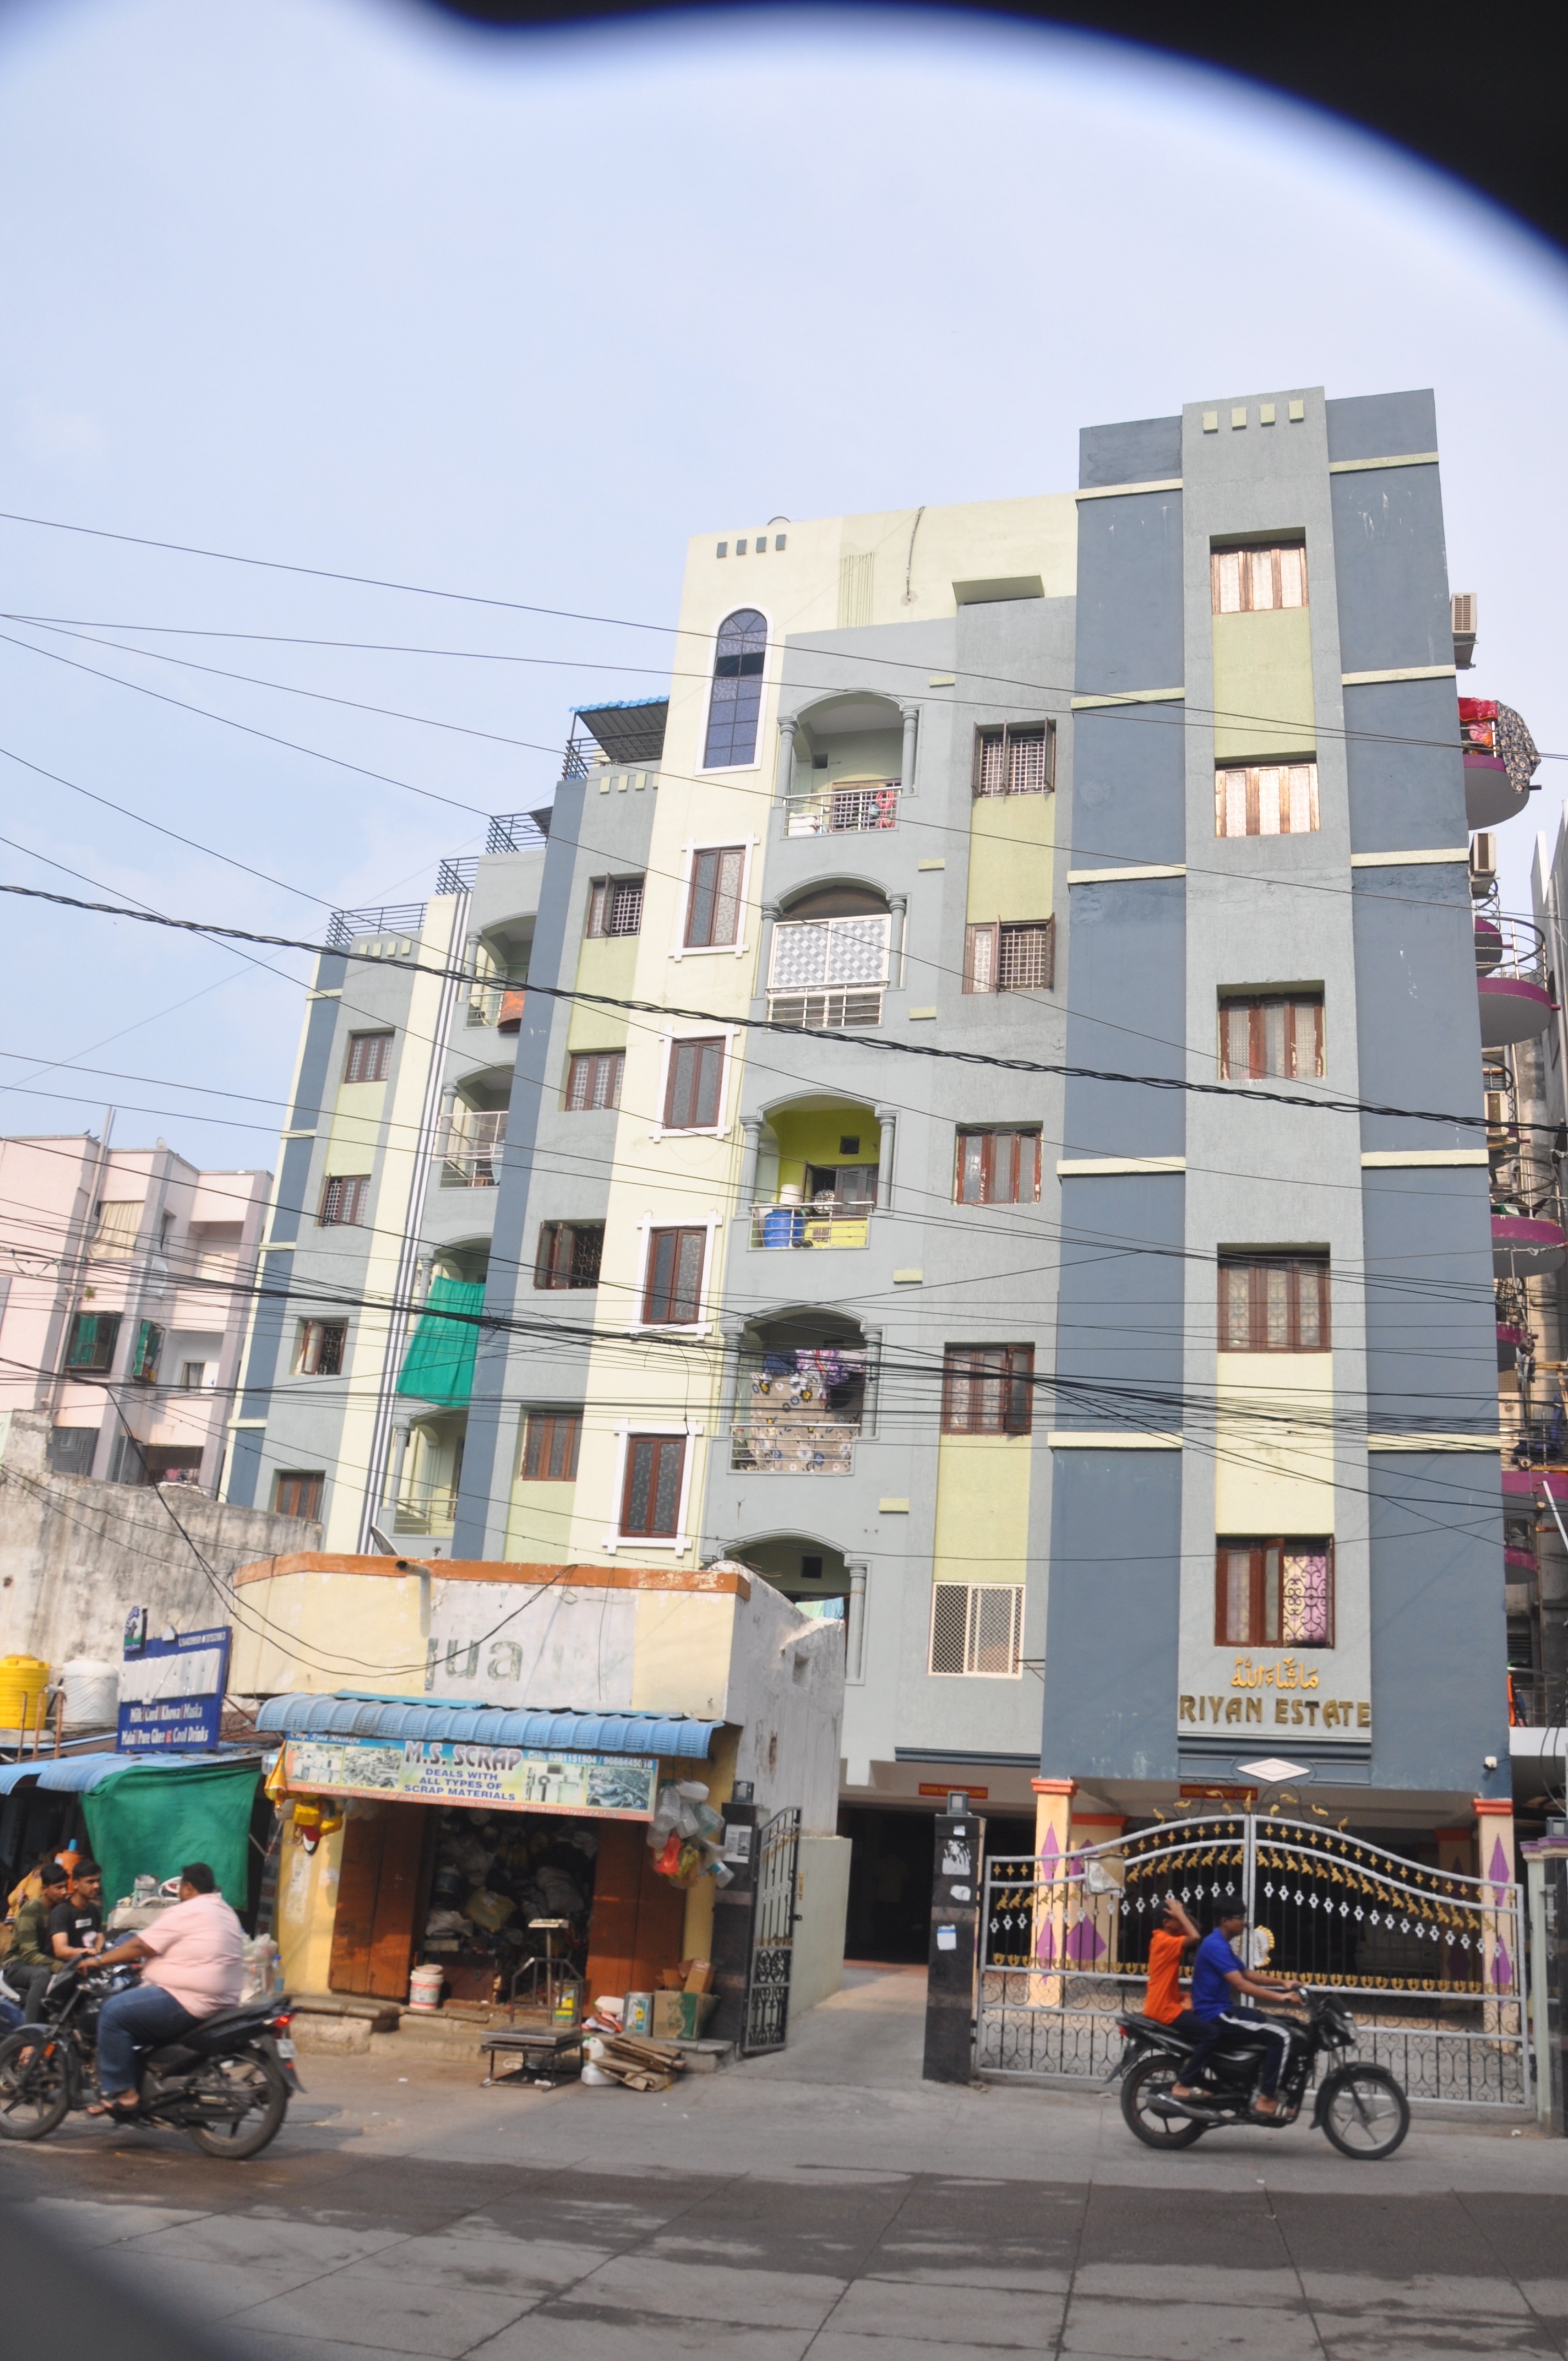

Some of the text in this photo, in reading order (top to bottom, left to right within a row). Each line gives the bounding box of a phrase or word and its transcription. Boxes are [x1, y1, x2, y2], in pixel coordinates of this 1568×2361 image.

[183, 1703, 203, 1719] Maska
[1179, 1695, 1371, 1728] RIYAN ESTATE
[138, 1729, 150, 1744] Pure
[151, 1728, 165, 1744] Ghee
[172, 1727, 188, 1743] Cool
[188, 1726, 209, 1742] Drinks
[311, 1733, 329, 1743] Syed
[329, 1734, 361, 1745] Mustafa
[405, 1740, 522, 1771] M.S. SCRAP
[426, 1768, 498, 1781] DEALS WITH
[420, 1777, 440, 1785] ALL
[445, 1778, 482, 1788] TYPES
[404, 1785, 515, 1800] SCRAP MATERIALS
